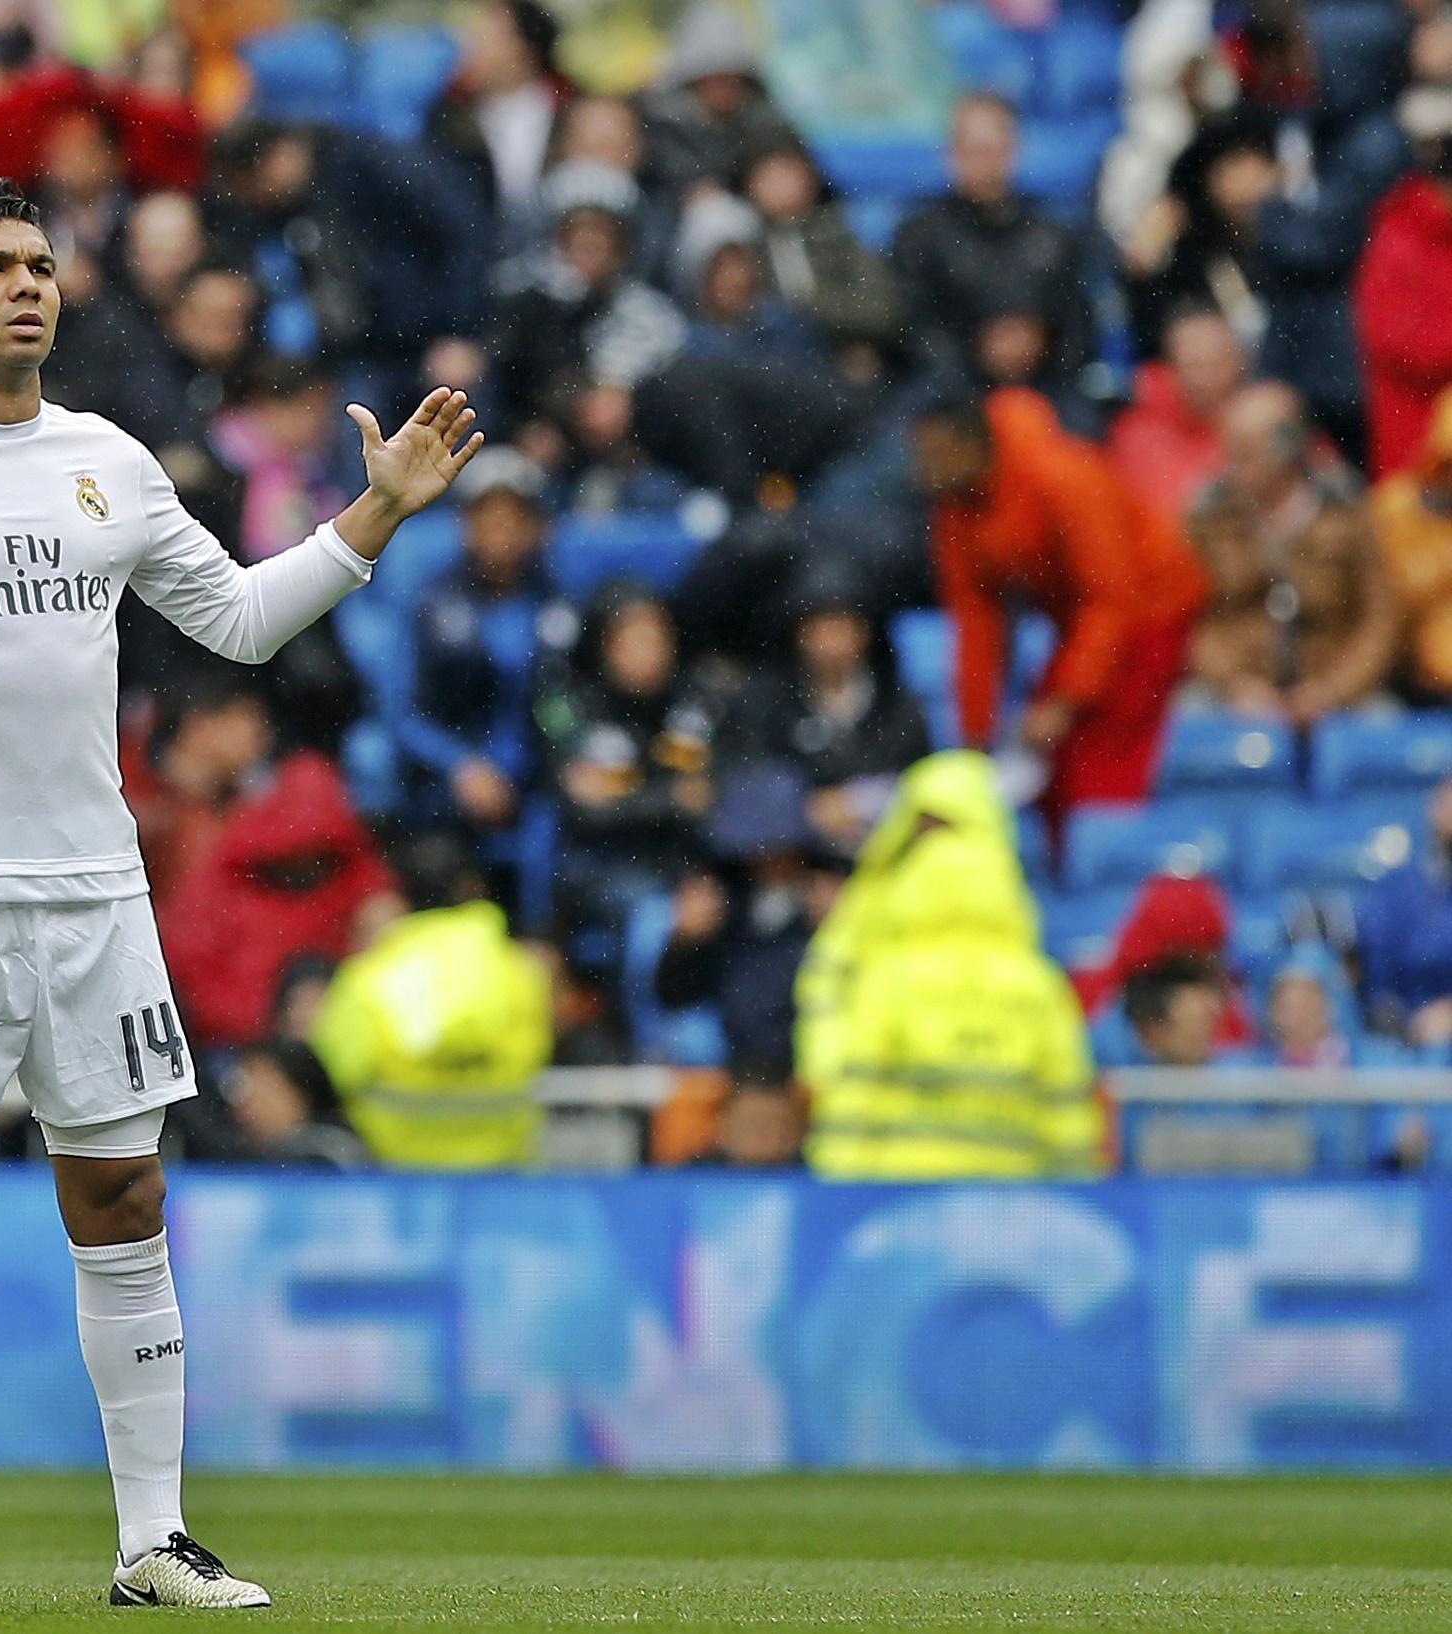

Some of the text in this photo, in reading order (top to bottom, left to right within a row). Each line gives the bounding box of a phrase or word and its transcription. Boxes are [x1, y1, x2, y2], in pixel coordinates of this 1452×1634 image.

[4, 534, 61, 568] Fly
[117, 1001, 184, 1092] 14
[135, 1338, 185, 1363] RMC
